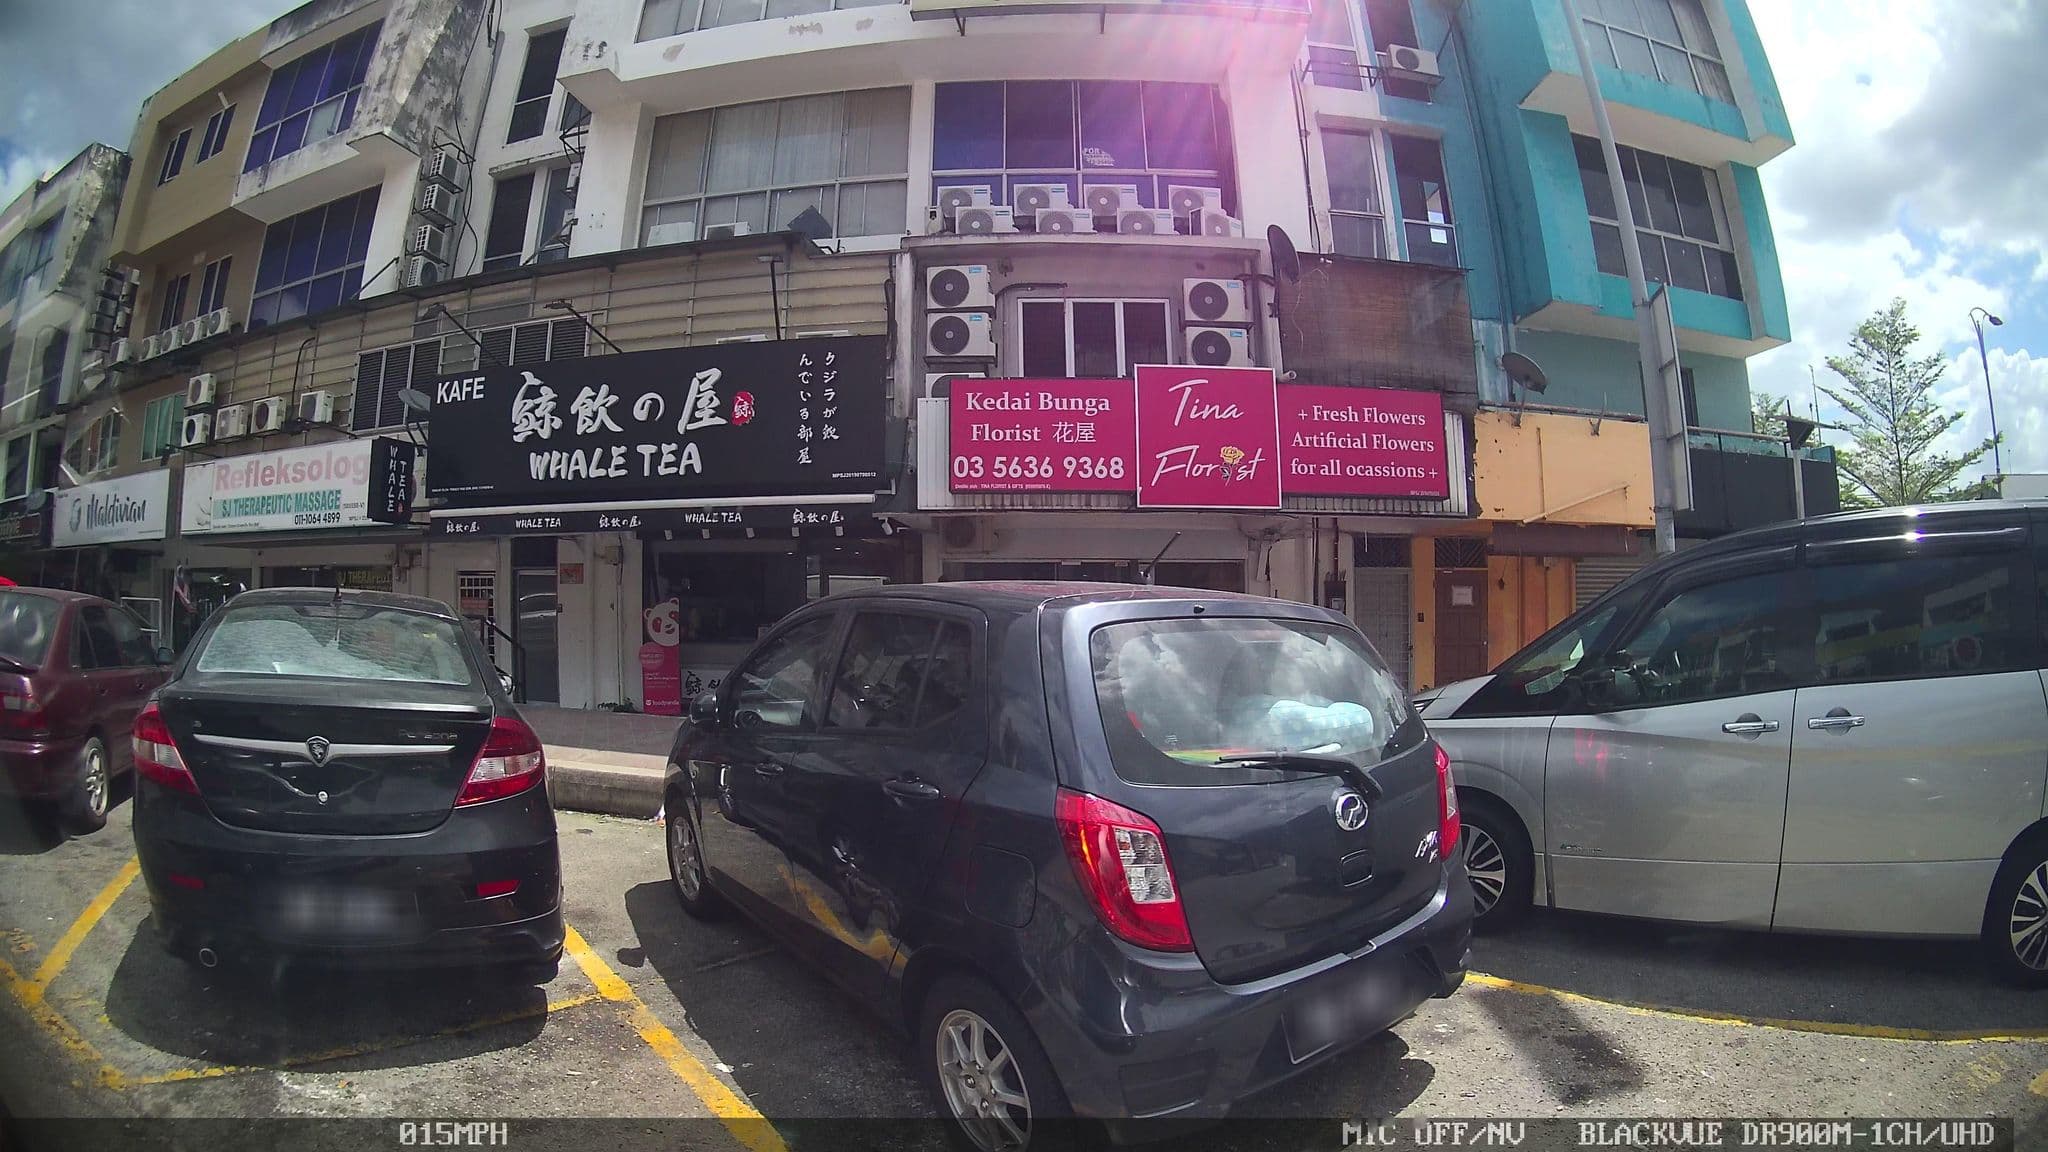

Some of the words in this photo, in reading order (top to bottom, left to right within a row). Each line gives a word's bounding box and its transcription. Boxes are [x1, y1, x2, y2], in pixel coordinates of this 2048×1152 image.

[436, 376, 486, 405] KAFE
[1168, 379, 1245, 426] Tina
[965, 391, 1032, 411] Kedai
[1037, 391, 1111, 417] Bunga
[1312, 405, 1359, 423] Fresh
[1363, 407, 1426, 426] Flowers
[971, 423, 1042, 442] Florist
[1052, 421, 1097, 444] 花屋
[1291, 431, 1368, 450] Artificial
[1372, 433, 1435, 452] Flowers
[529, 445, 629, 481] WHALE
[636, 442, 703, 477] TEA
[953, 455, 985, 479] 03
[992, 456, 1054, 479] 5636
[1063, 456, 1125, 480] 9368
[1290, 457, 1317, 476] for
[1320, 459, 1342, 477] all
[1346, 461, 1426, 479] ocassions
[387, 444, 398, 513] WHALE
[398, 461, 407, 501] TEA
[86, 493, 147, 529] Maldivian
[222, 499, 233, 518] SJ
[234, 492, 294, 517] THERAPEUTIC
[294, 489, 342, 514] MASSAGE
[515, 518, 543, 529] WHALE
[544, 517, 561, 528] TEA
[685, 512, 719, 523] WHALE
[721, 511, 742, 523] TEA
